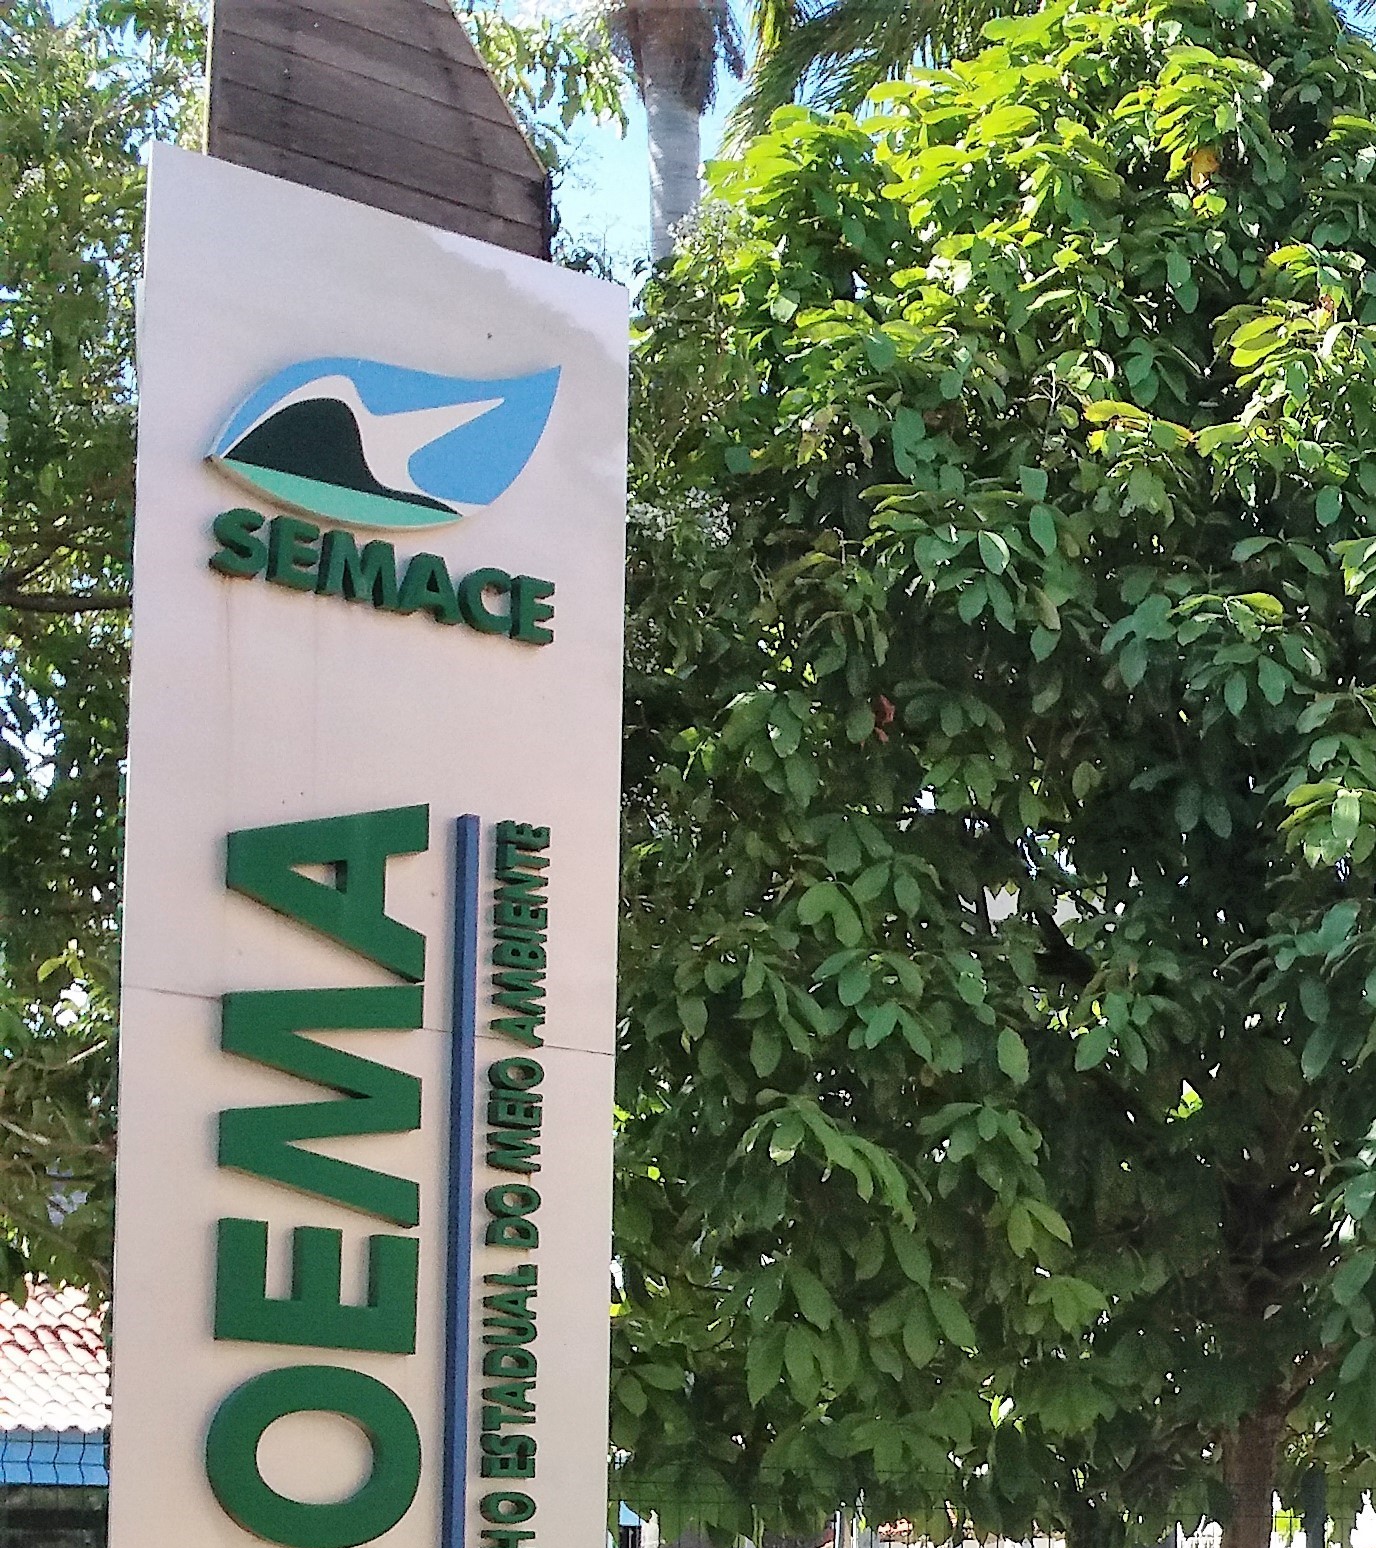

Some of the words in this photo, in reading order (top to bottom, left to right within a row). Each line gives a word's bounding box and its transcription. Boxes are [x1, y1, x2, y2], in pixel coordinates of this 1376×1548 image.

[210, 508, 555, 645] SEMACE
[490, 820, 551, 1048] AMBIENTE
[487, 1056, 545, 1173] MEIO
[485, 1181, 541, 1249] DO
[481, 1264, 539, 1479] ESTADUAL
